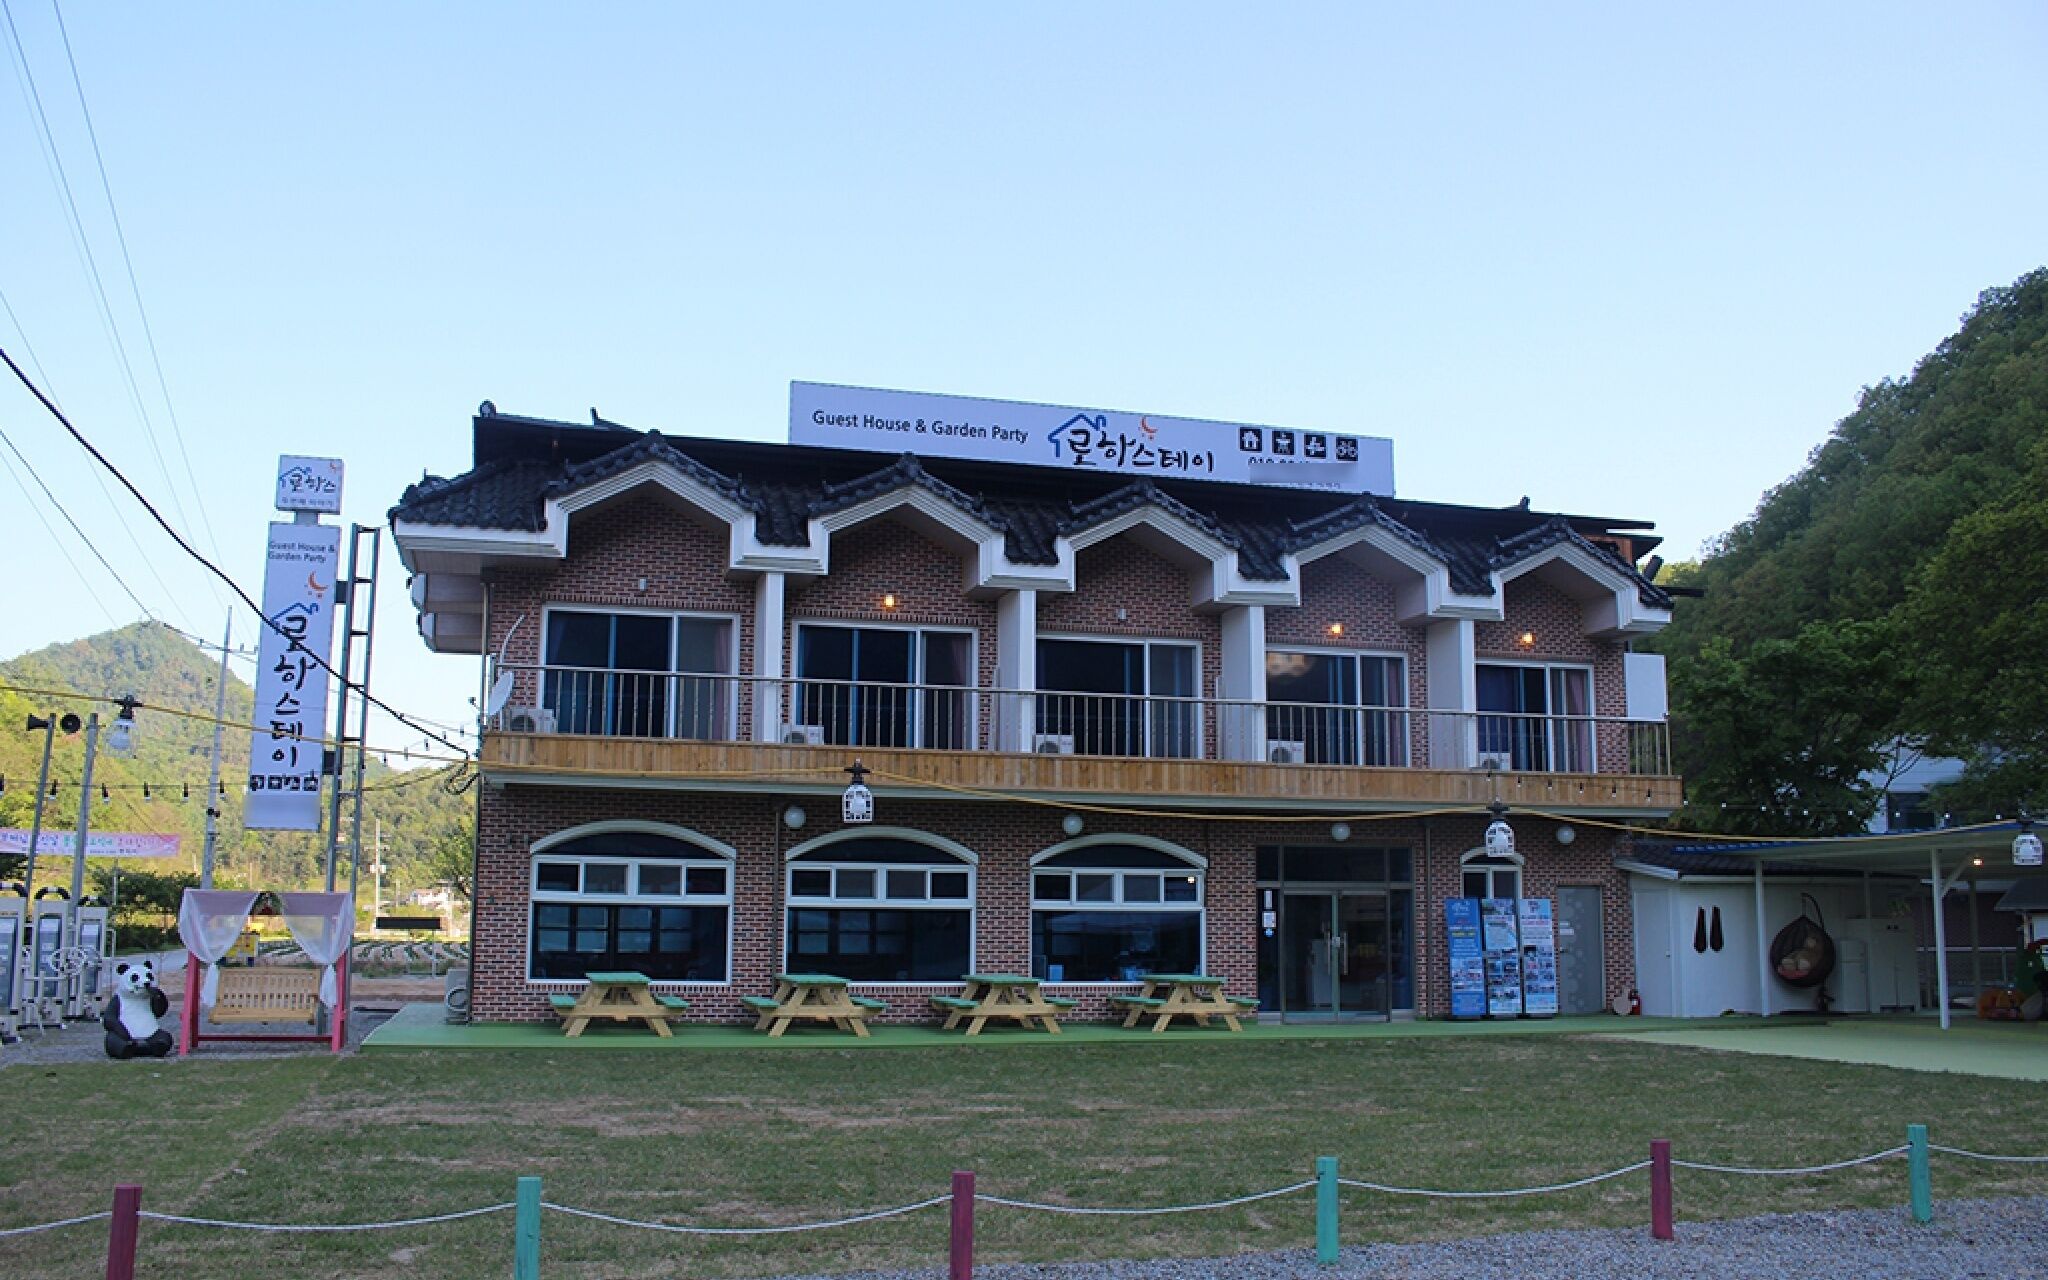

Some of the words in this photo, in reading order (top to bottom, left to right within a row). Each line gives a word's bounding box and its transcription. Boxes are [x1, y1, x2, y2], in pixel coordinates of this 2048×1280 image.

[812, 409, 859, 428] Guest
[863, 413, 911, 432] House
[915, 418, 927, 434] &
[931, 419, 987, 438] Garden
[991, 424, 1029, 445] Party
[1068, 428, 1216, 473] 로하스테이
[269, 542, 296, 550] Guest
[297, 542, 327, 552] House
[328, 544, 335, 553] &
[269, 551, 303, 561] Garden
[303, 552, 327, 564] Party
[270, 615, 318, 767] 로하스테이
